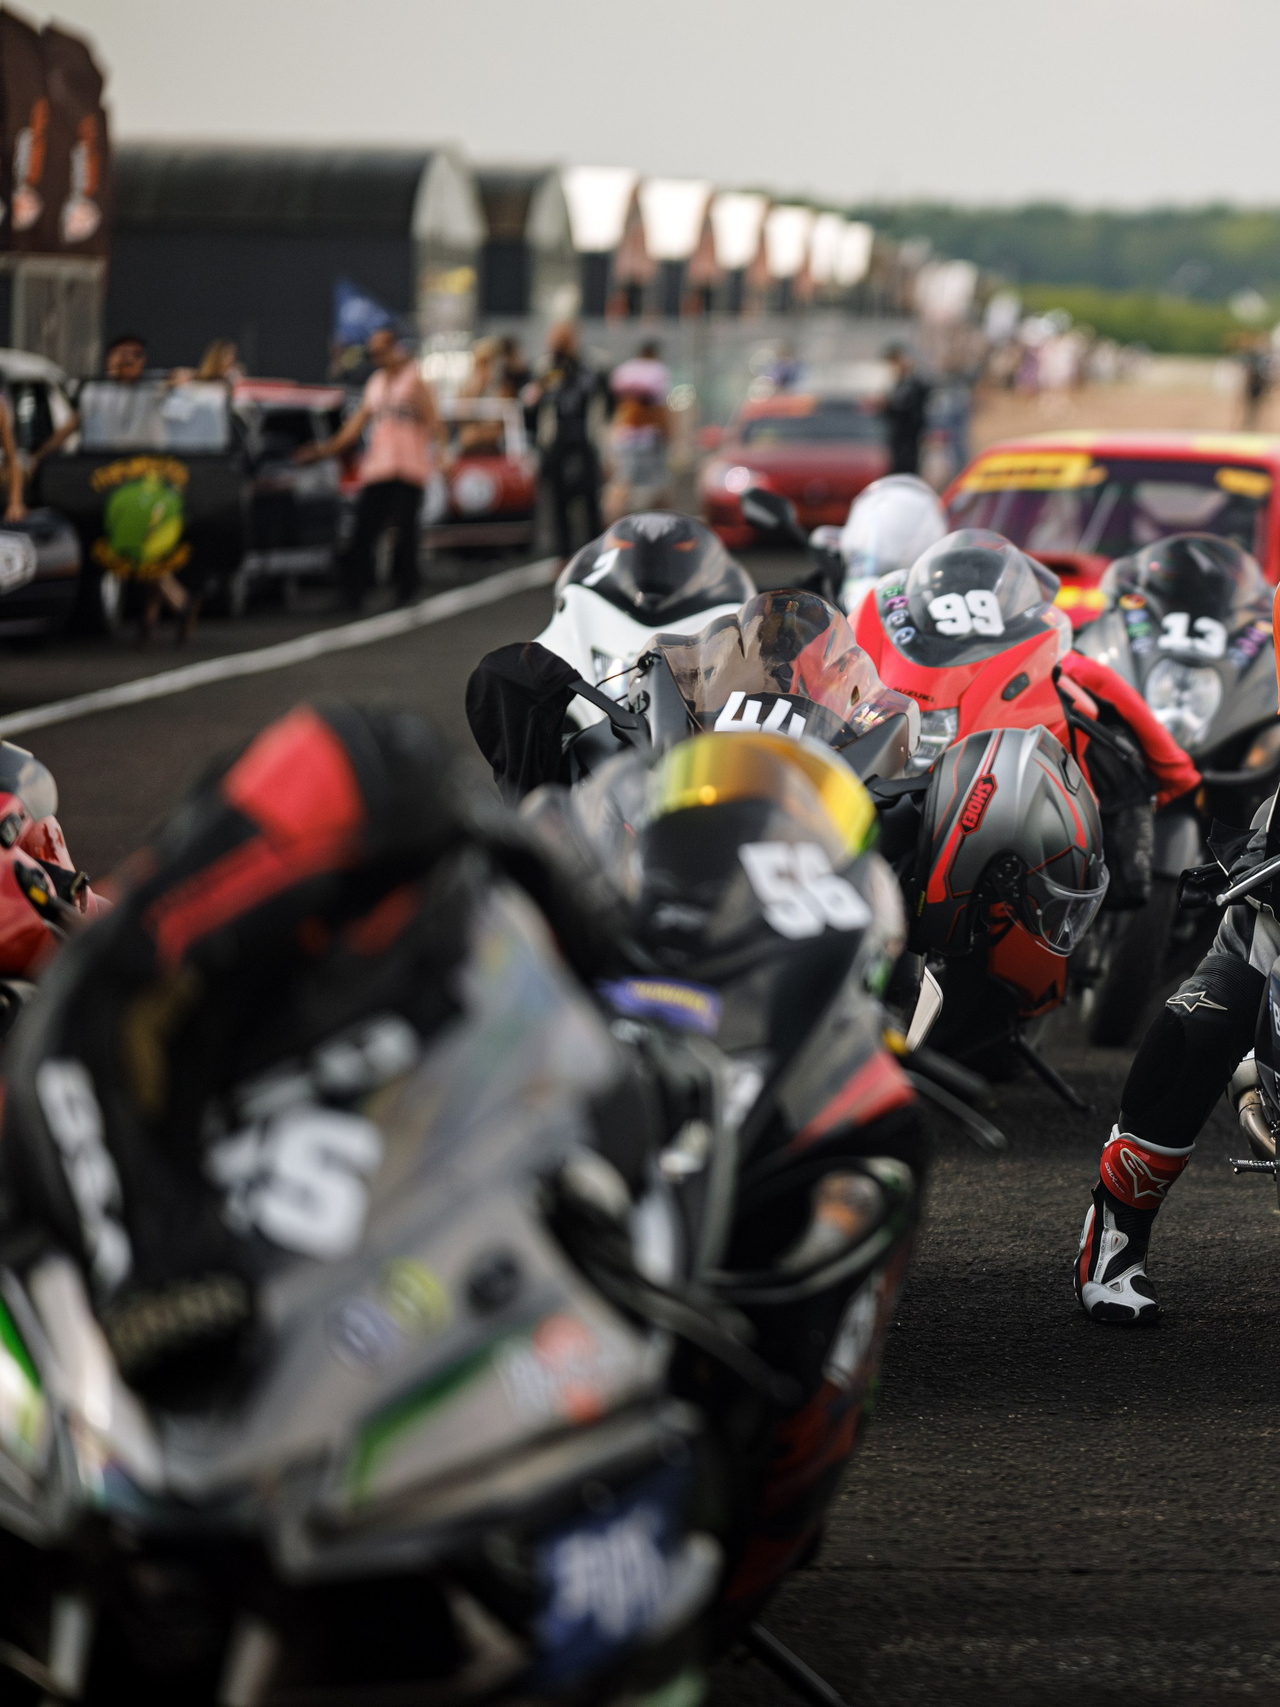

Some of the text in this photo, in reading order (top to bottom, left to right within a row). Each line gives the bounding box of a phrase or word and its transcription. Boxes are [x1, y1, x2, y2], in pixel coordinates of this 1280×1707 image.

[927, 589, 1005, 637] 99
[1156, 611, 1228, 658] 13
[961, 780, 993, 829] SHOEI
[738, 840, 874, 941] 56
